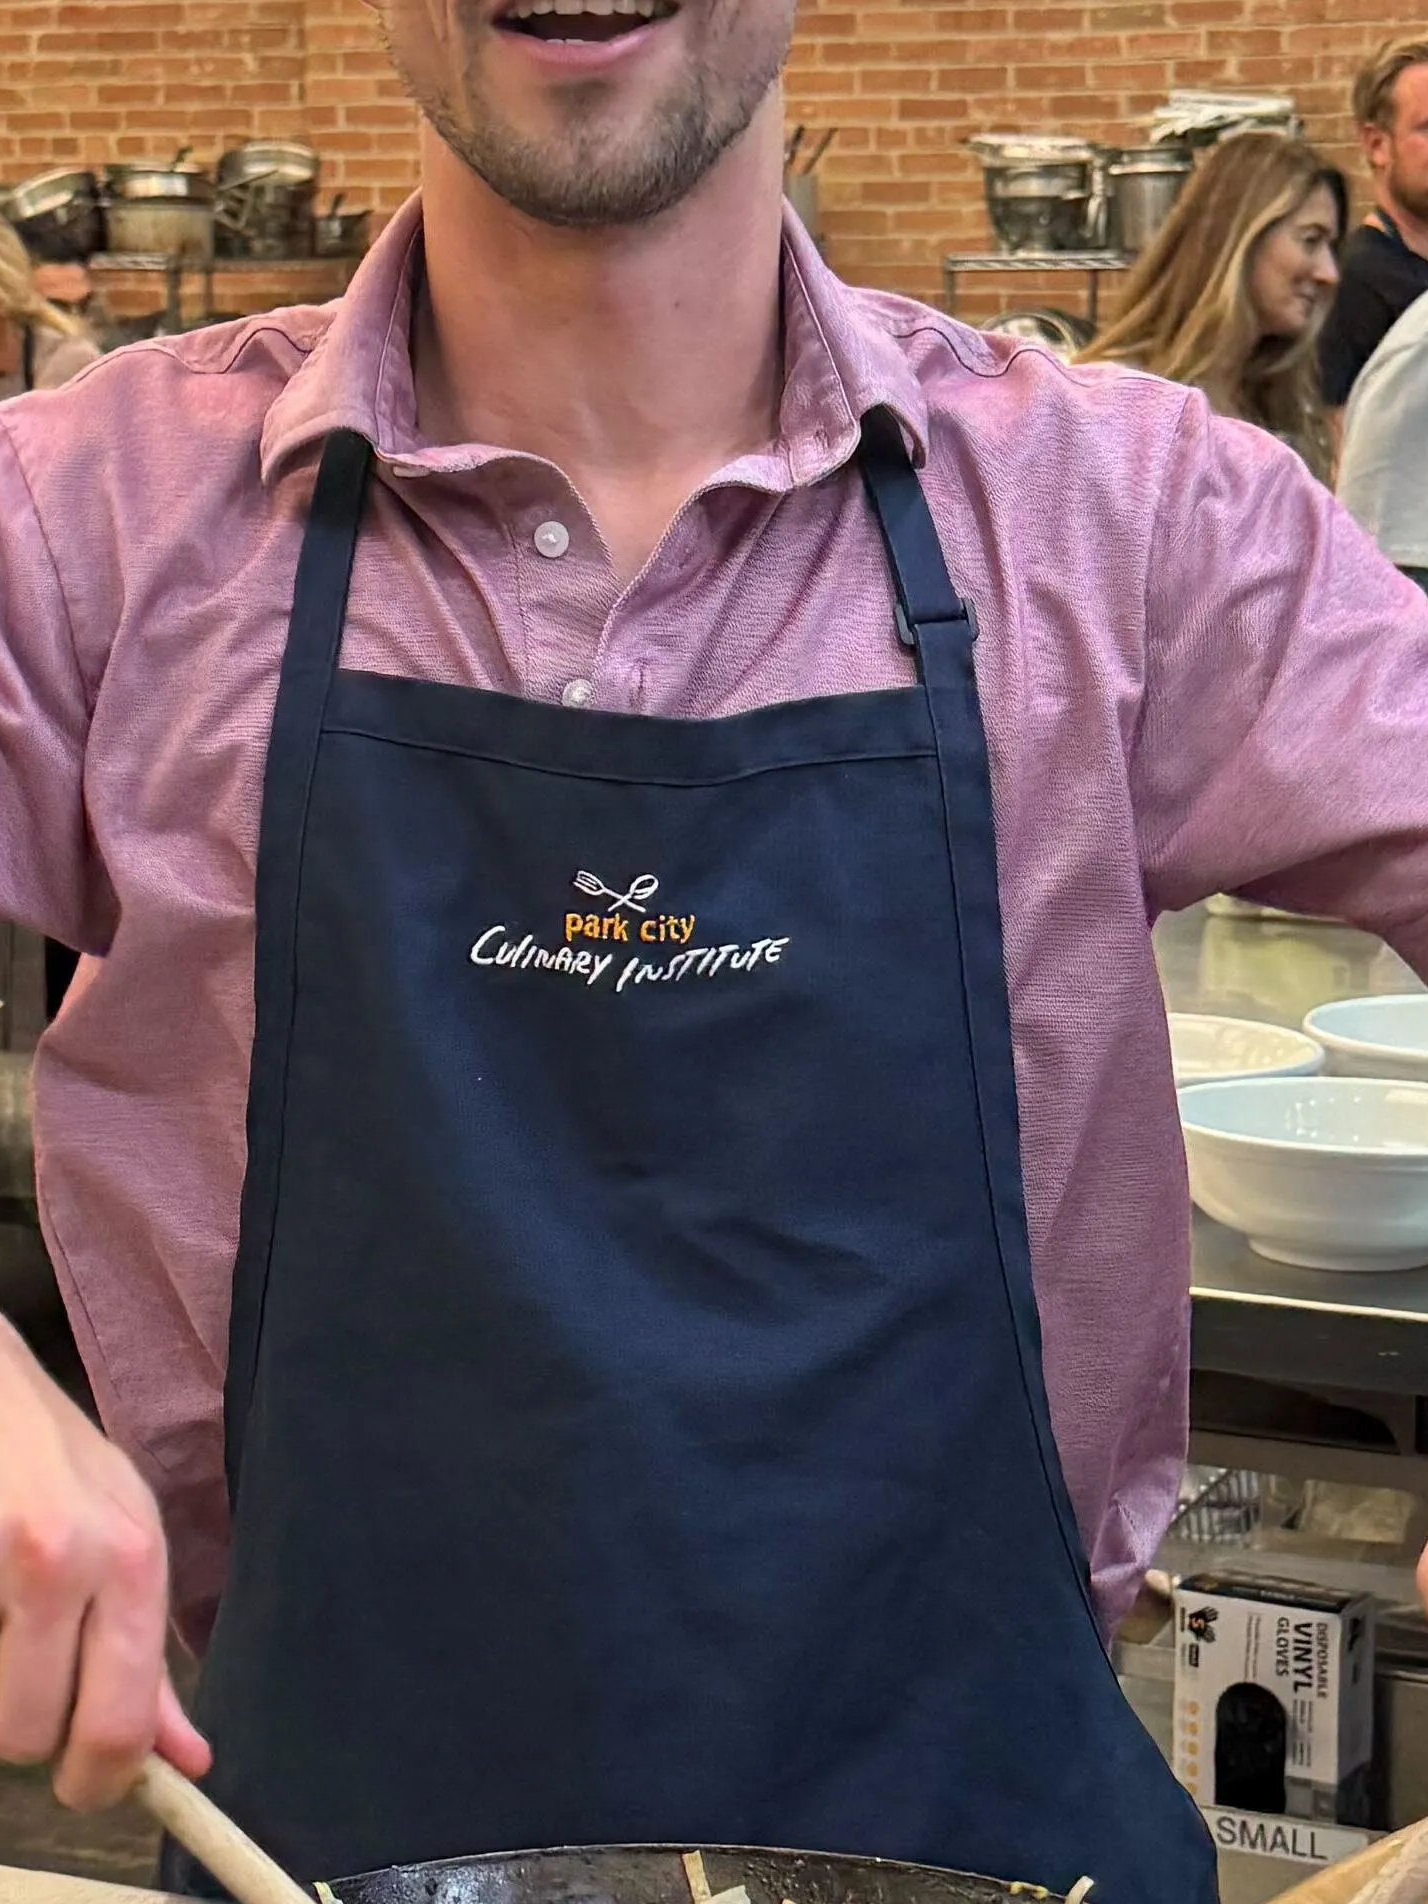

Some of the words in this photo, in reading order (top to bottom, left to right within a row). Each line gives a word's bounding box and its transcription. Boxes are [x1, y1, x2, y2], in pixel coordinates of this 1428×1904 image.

[565, 912, 628, 943] park
[640, 913, 696, 945] city
[1276, 1617, 1290, 1678] GLOVES
[1293, 1622, 1313, 1694] VINYL
[1316, 1622, 1329, 1700] DISPOSABLE
[1216, 1816, 1328, 1860] SMALL
